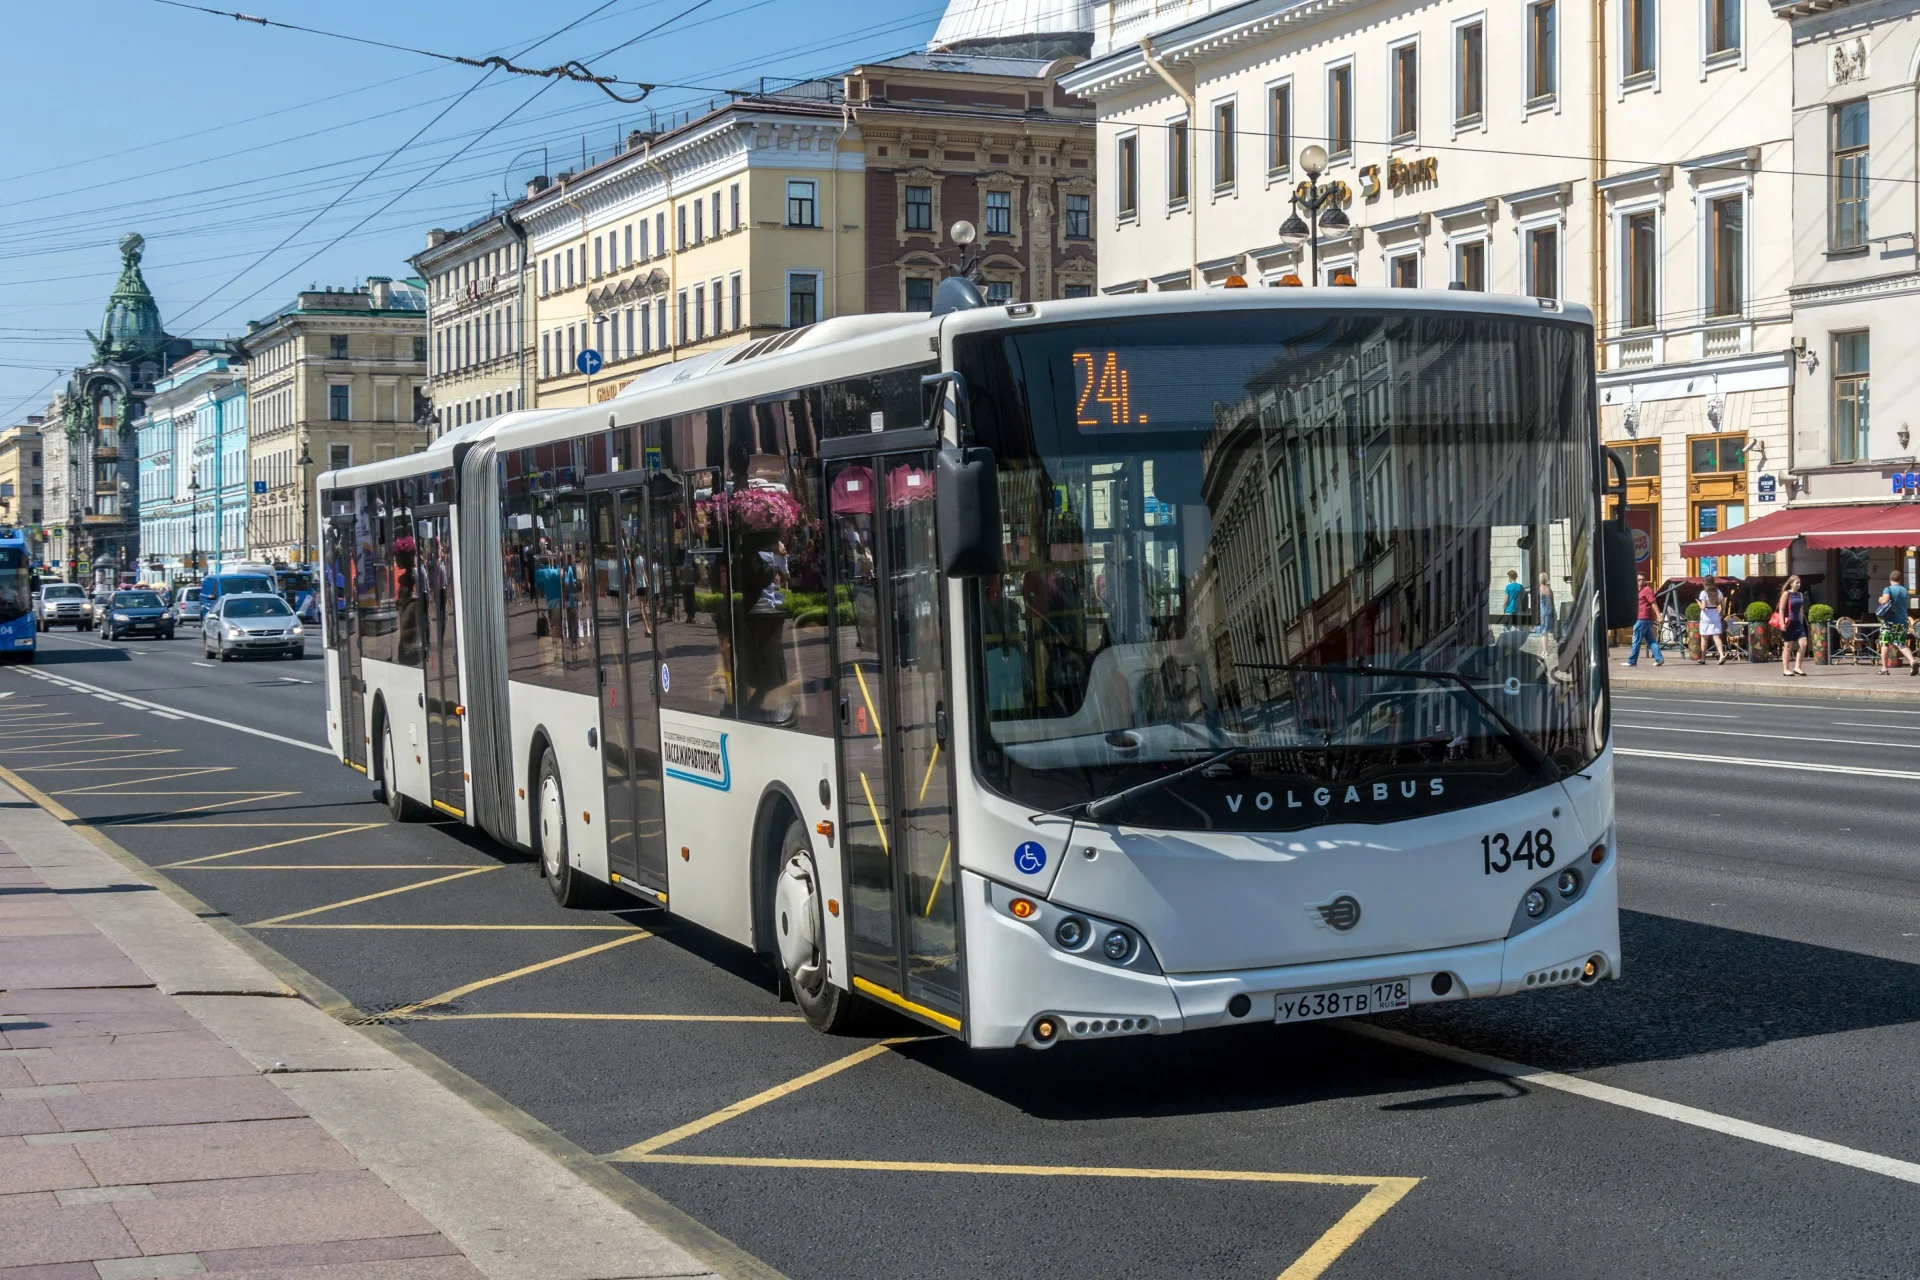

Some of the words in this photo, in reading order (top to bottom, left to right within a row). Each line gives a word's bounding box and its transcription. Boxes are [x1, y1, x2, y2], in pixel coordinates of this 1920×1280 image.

[1225, 778, 1445, 813] VOLGABUS
[1480, 828, 1556, 875] 1348
[1374, 983, 1404, 1002] 178
[1379, 1000, 1395, 1009] RUS
